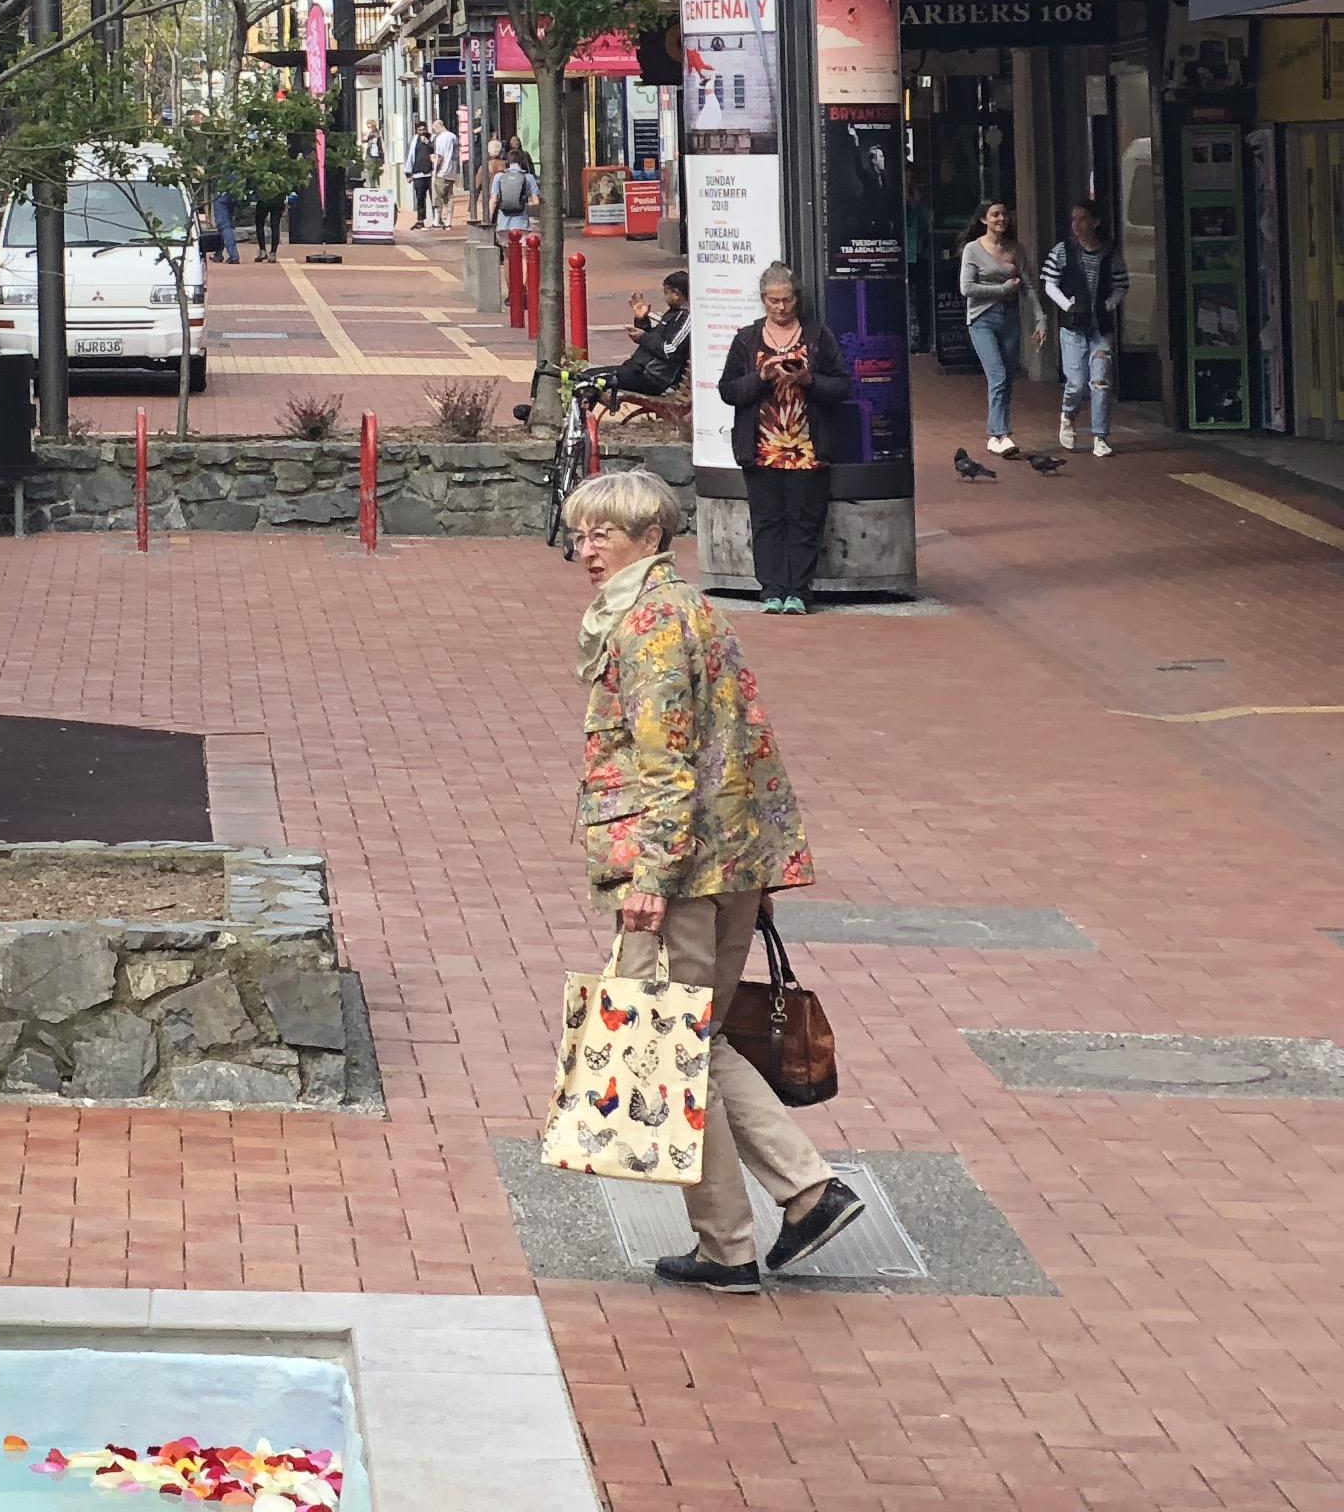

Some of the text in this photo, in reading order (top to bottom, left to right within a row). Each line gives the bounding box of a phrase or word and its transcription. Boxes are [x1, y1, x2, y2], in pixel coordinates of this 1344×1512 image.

[901, 2, 1093, 25] ARBERS 108
[705, 175, 736, 186] SUNDAY
[359, 194, 389, 203] Check
[705, 188, 747, 199] NOVEMBER
[711, 200, 730, 211] 2018
[358, 210, 389, 219] hearing
[698, 240, 752, 252] NATIONAL WAR
[696, 252, 757, 265] MEMORIAL PARK
